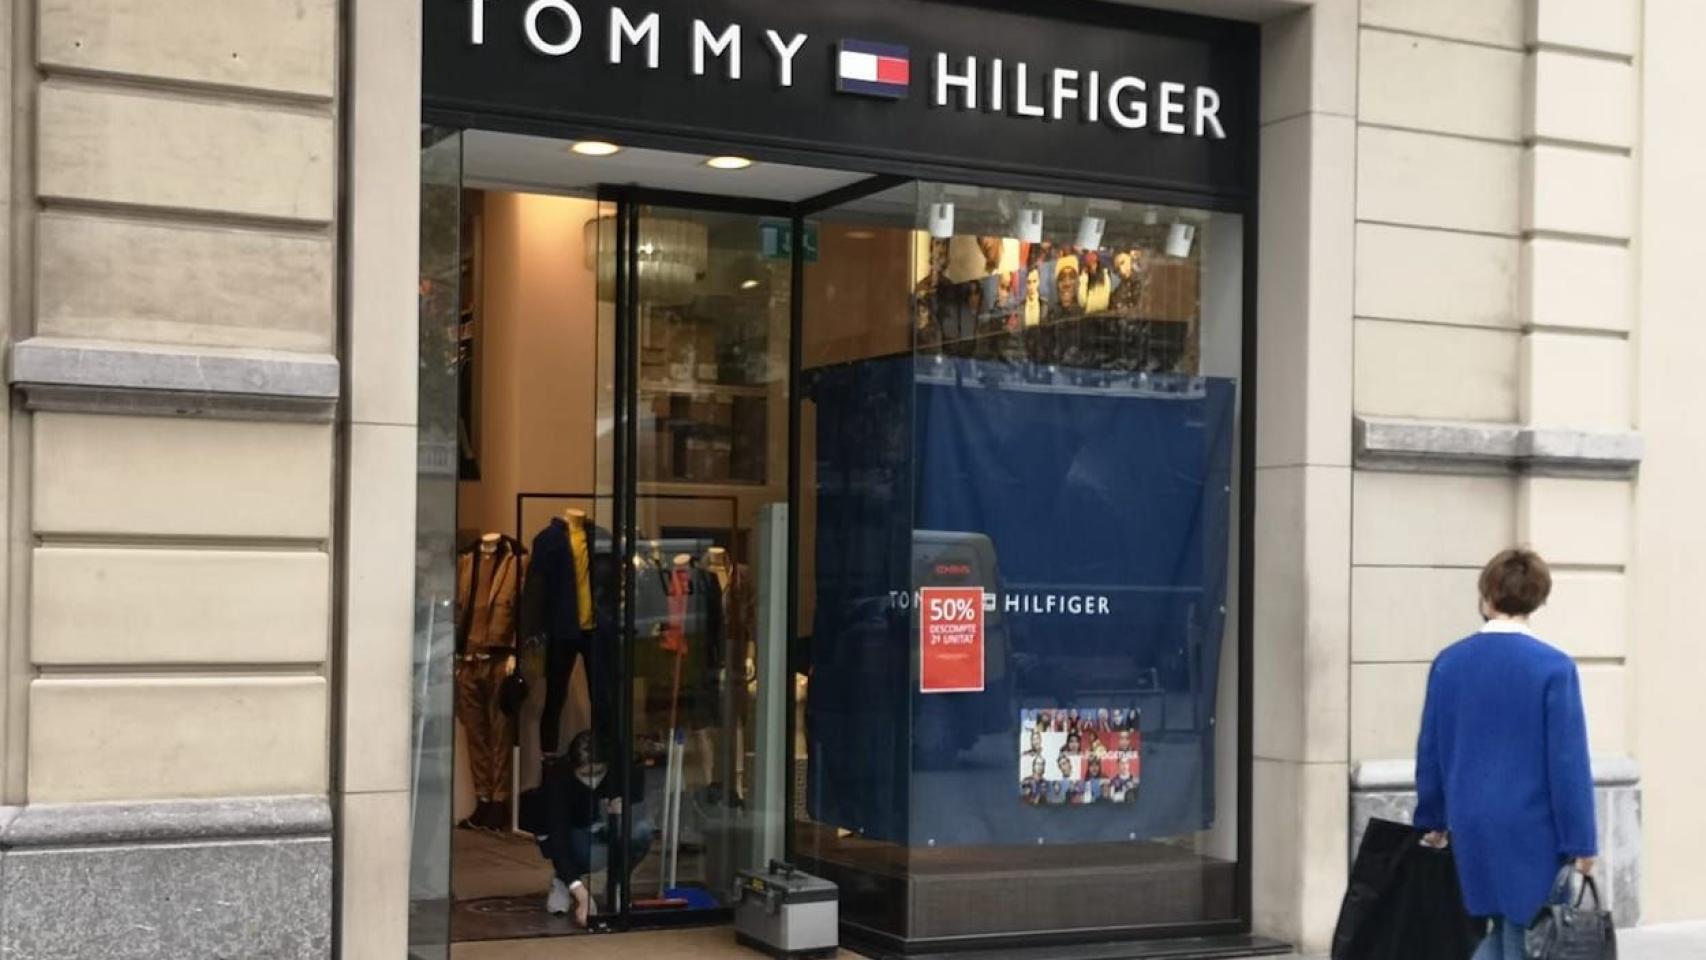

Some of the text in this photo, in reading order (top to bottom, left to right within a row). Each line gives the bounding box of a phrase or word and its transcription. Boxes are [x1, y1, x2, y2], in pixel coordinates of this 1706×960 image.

[936, 51, 1227, 140] HILFIGER
[929, 597, 976, 621] 50%
[1004, 593, 1111, 614] HILFIGER
